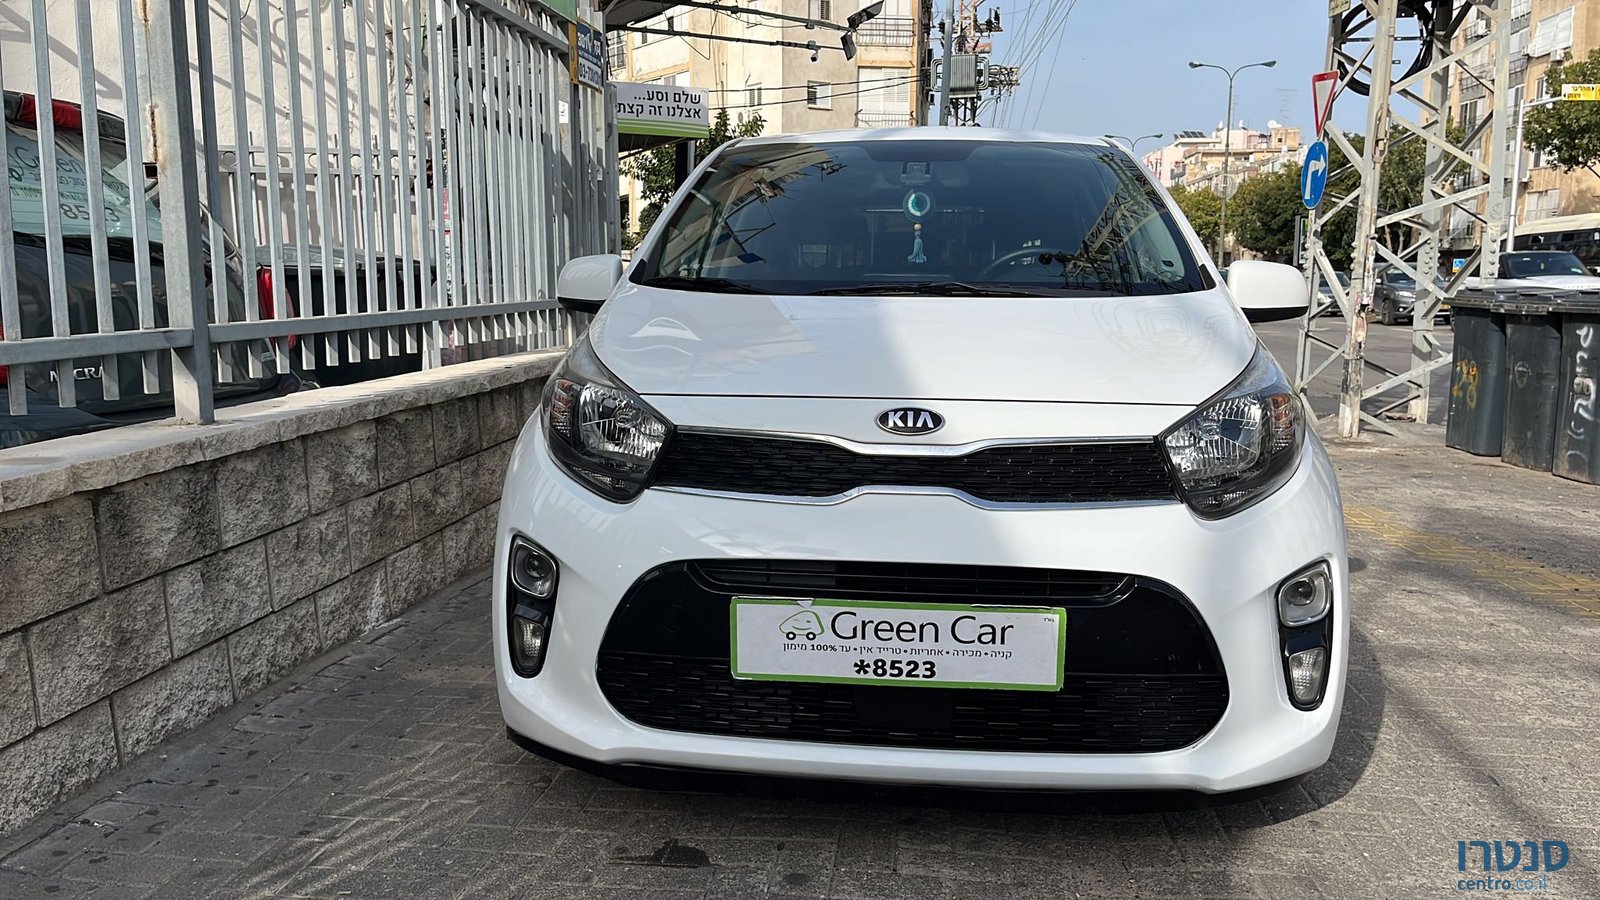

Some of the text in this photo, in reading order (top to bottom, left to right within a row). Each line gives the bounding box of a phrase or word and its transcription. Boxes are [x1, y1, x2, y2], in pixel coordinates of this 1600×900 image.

[634, 90, 701, 104] שלם וסע...
[617, 102, 701, 119] אצלנו זה קצת
[887, 411, 934, 428] KIA
[831, 611, 1014, 645] Green Car
[783, 643, 1013, 660] קניה מכירה אחריות טרייד אין עד 100% מימון
